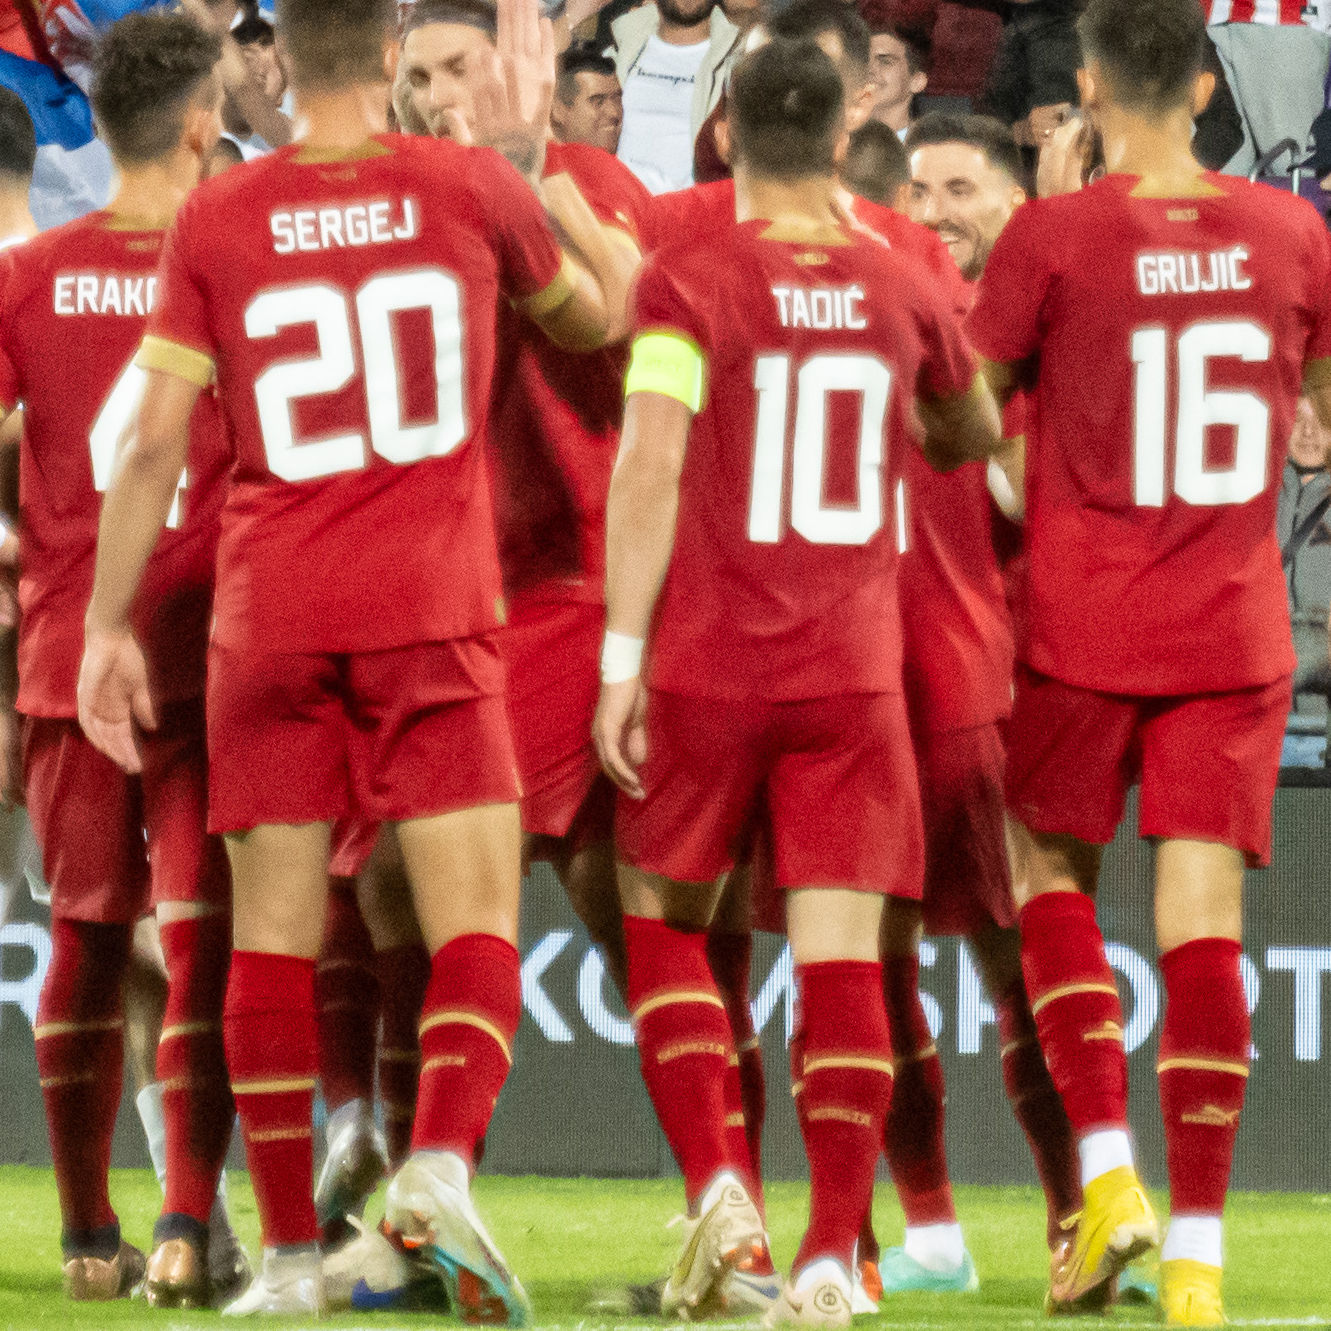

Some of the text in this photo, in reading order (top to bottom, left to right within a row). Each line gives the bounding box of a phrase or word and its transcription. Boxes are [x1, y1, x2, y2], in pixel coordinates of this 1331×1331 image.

[270, 198, 416, 255] SERGEJ
[1137, 246, 1252, 295] GRUJIĆ
[772, 284, 868, 330] TADIĆ
[244, 270, 466, 484] 20
[1132, 323, 1270, 508] 16
[748, 355, 892, 545] 10
